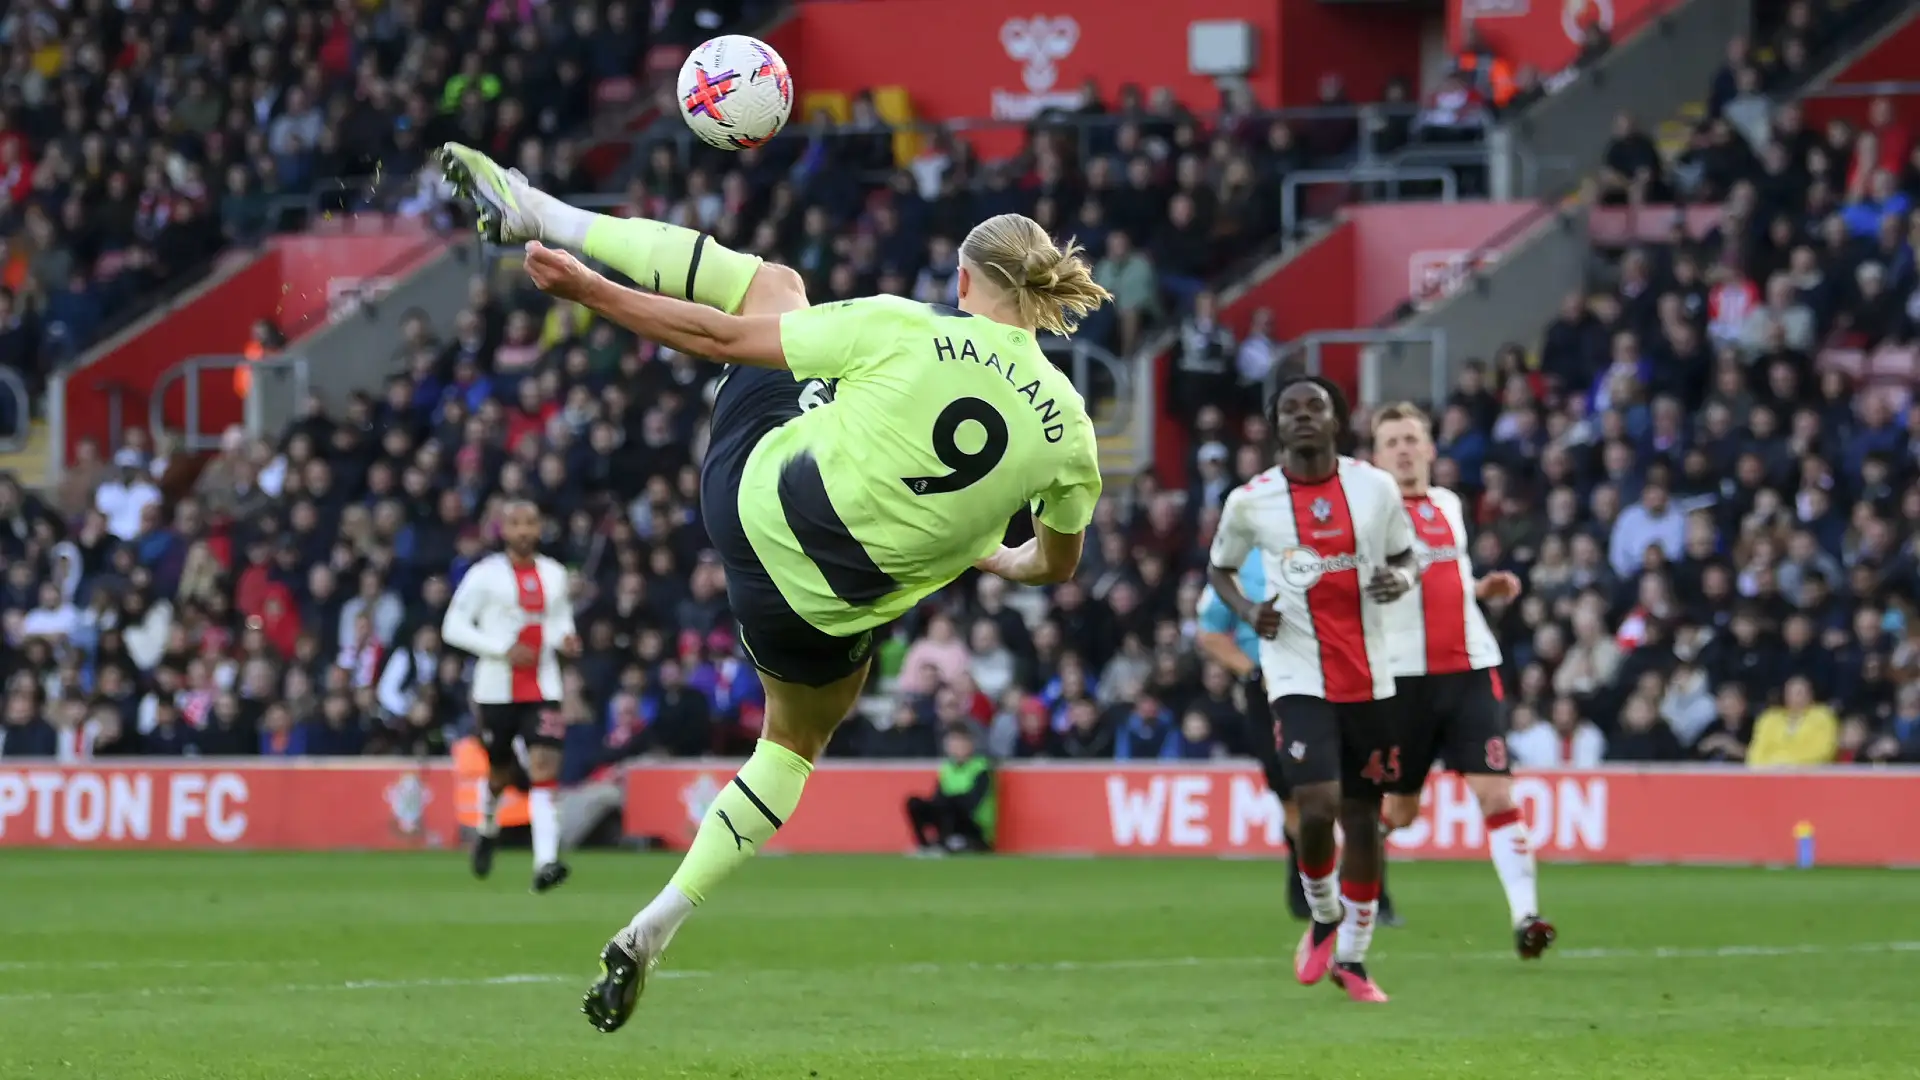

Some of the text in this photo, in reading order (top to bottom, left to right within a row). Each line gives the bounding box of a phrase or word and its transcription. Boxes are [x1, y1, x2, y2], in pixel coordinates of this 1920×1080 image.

[933, 336, 1064, 443] HAALAND
[900, 396, 1009, 496] 9
[1359, 745, 1401, 785] 45
[1483, 736, 1508, 771] 8
[0, 771, 249, 843] PTON FC
[1106, 775, 1608, 850] WE MCH ON
